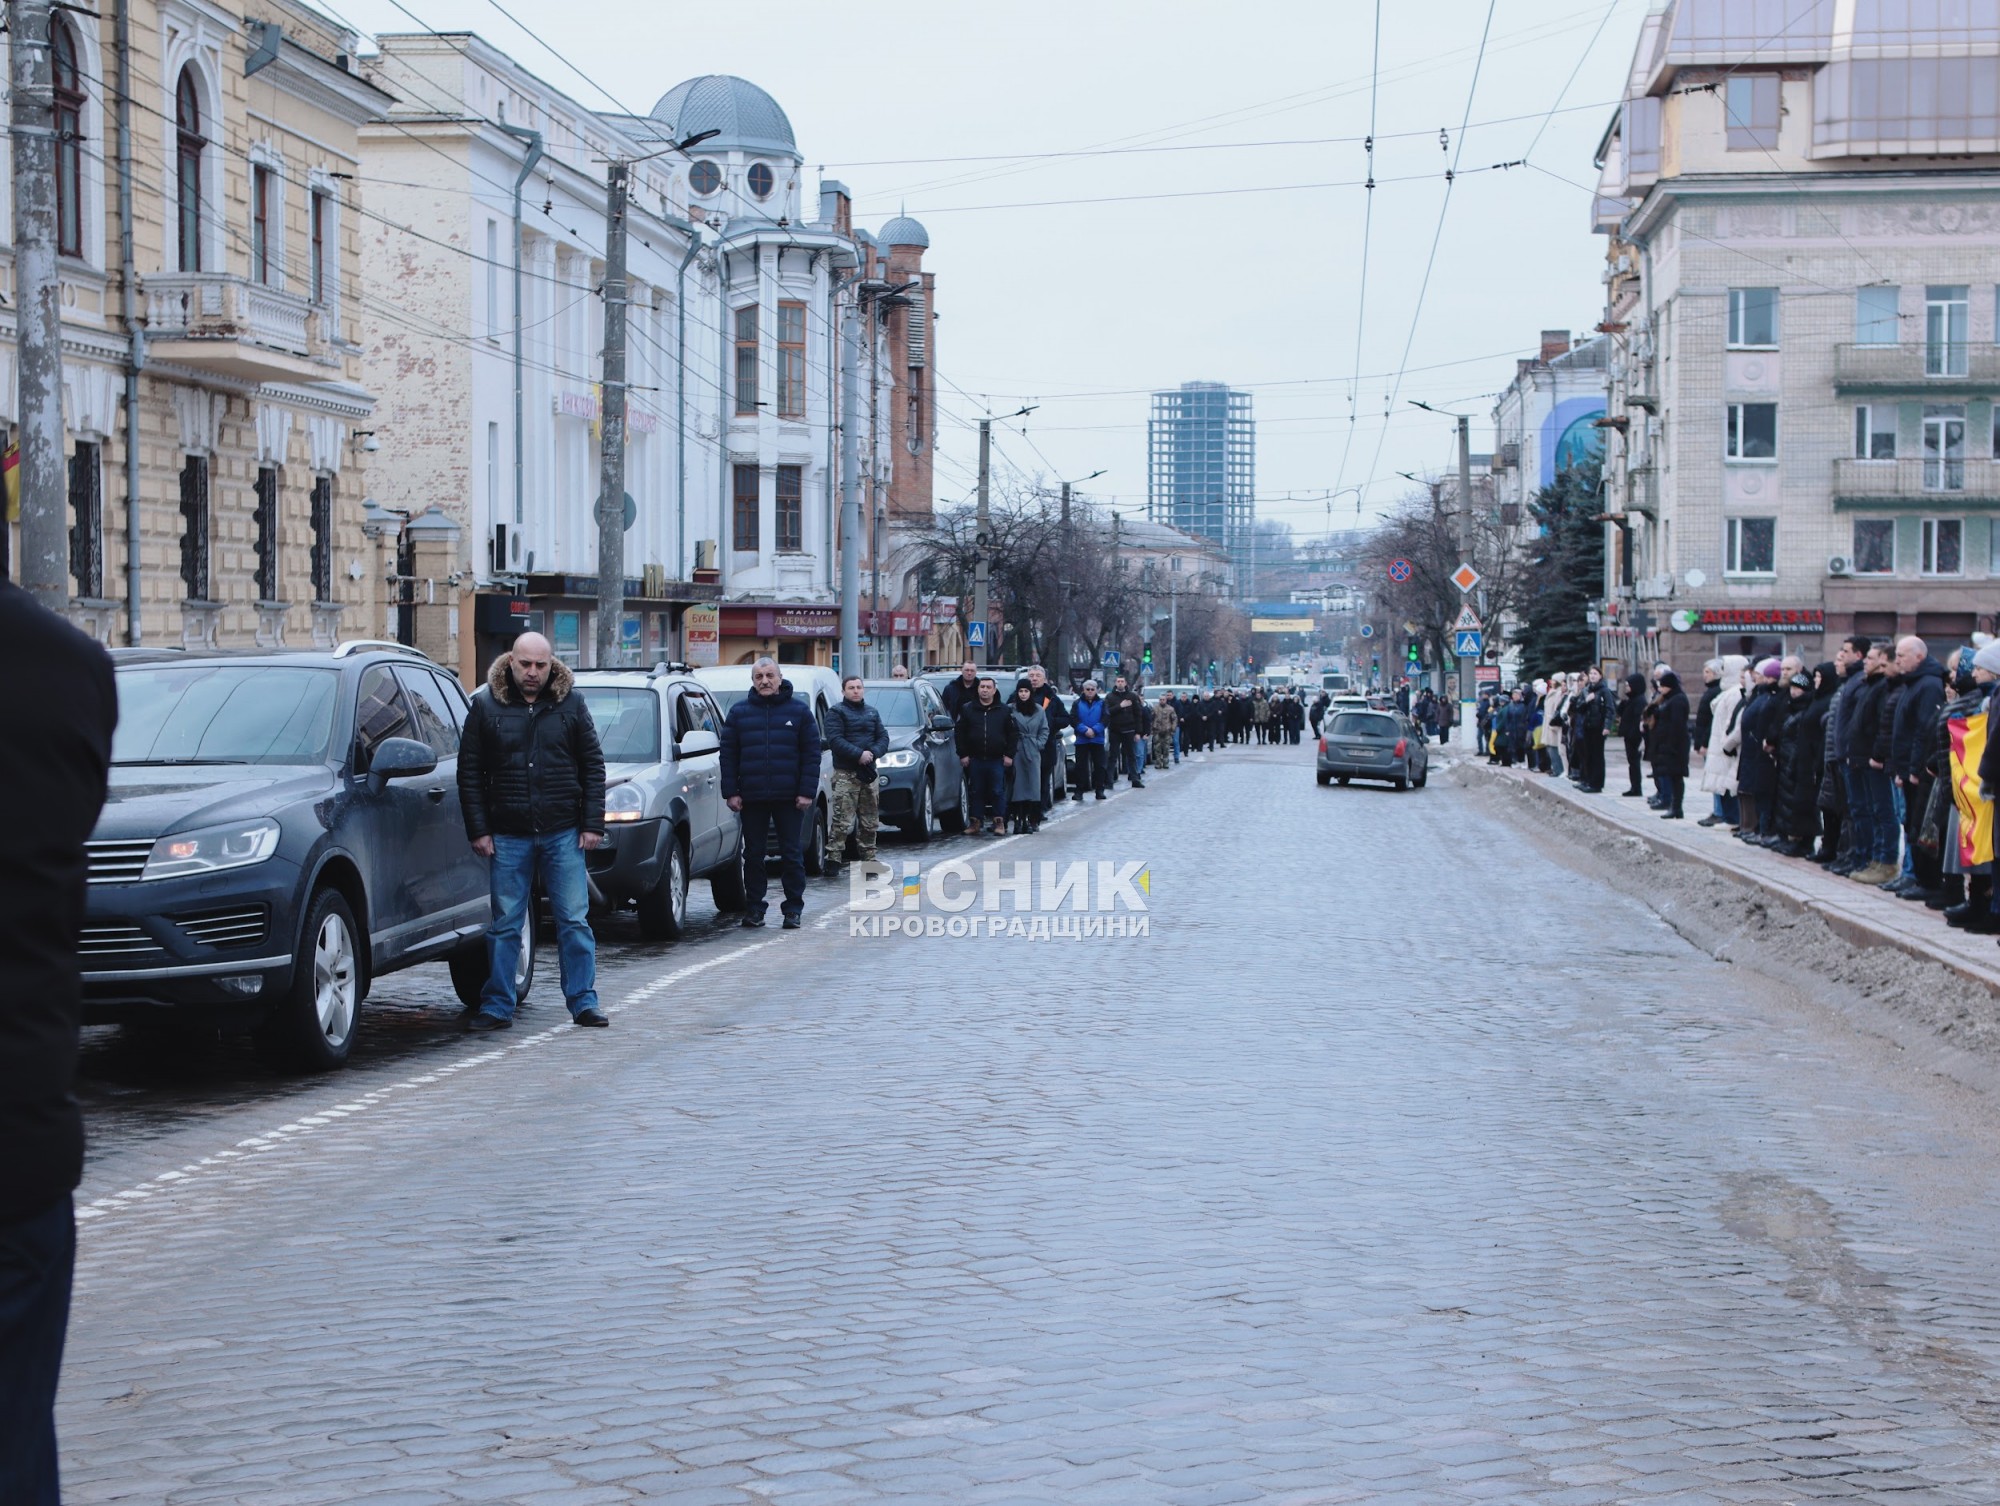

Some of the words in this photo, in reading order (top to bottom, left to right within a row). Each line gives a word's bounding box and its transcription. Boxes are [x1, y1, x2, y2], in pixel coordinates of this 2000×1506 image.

[1702, 609, 1783, 624] АПТЕКА
[1702, 624, 1739, 632] ГОЛОВНА
[1740, 624, 1771, 632] АПТЕКА
[1773, 624, 1798, 632] ТВОГО
